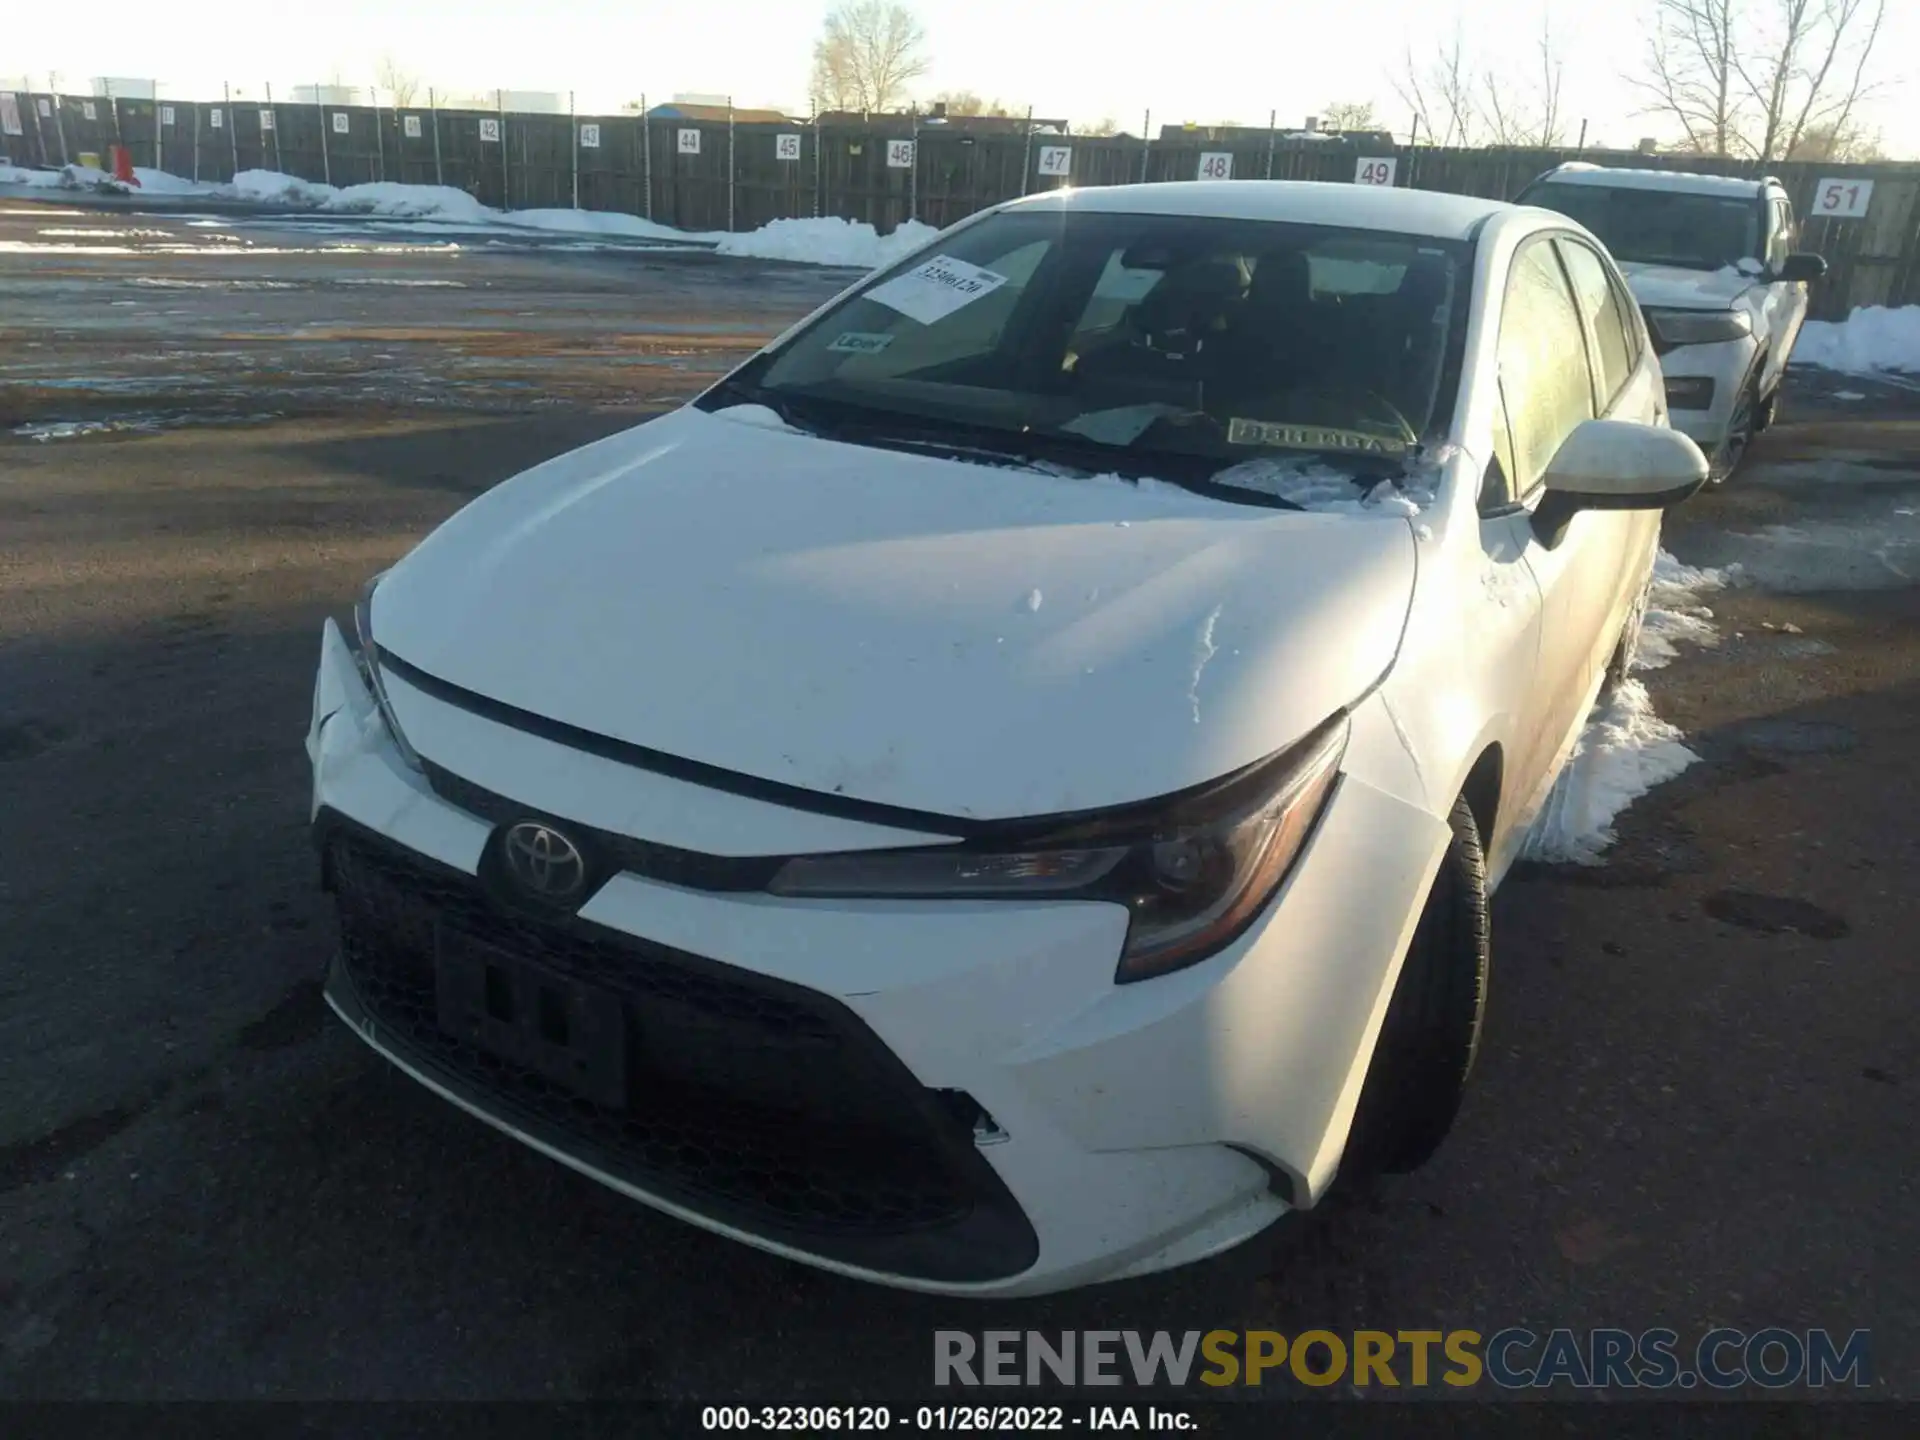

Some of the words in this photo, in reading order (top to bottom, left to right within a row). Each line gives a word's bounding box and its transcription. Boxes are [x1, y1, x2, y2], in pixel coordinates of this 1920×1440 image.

[482, 121, 497, 138] 42
[582, 127, 597, 143] 43
[681, 132, 696, 149] 44
[779, 138, 797, 156] 45
[891, 143, 909, 164] 46
[1044, 150, 1067, 171] 47
[1203, 157, 1226, 178] 48
[1360, 163, 1390, 185] 49
[1822, 183, 1860, 210] 51
